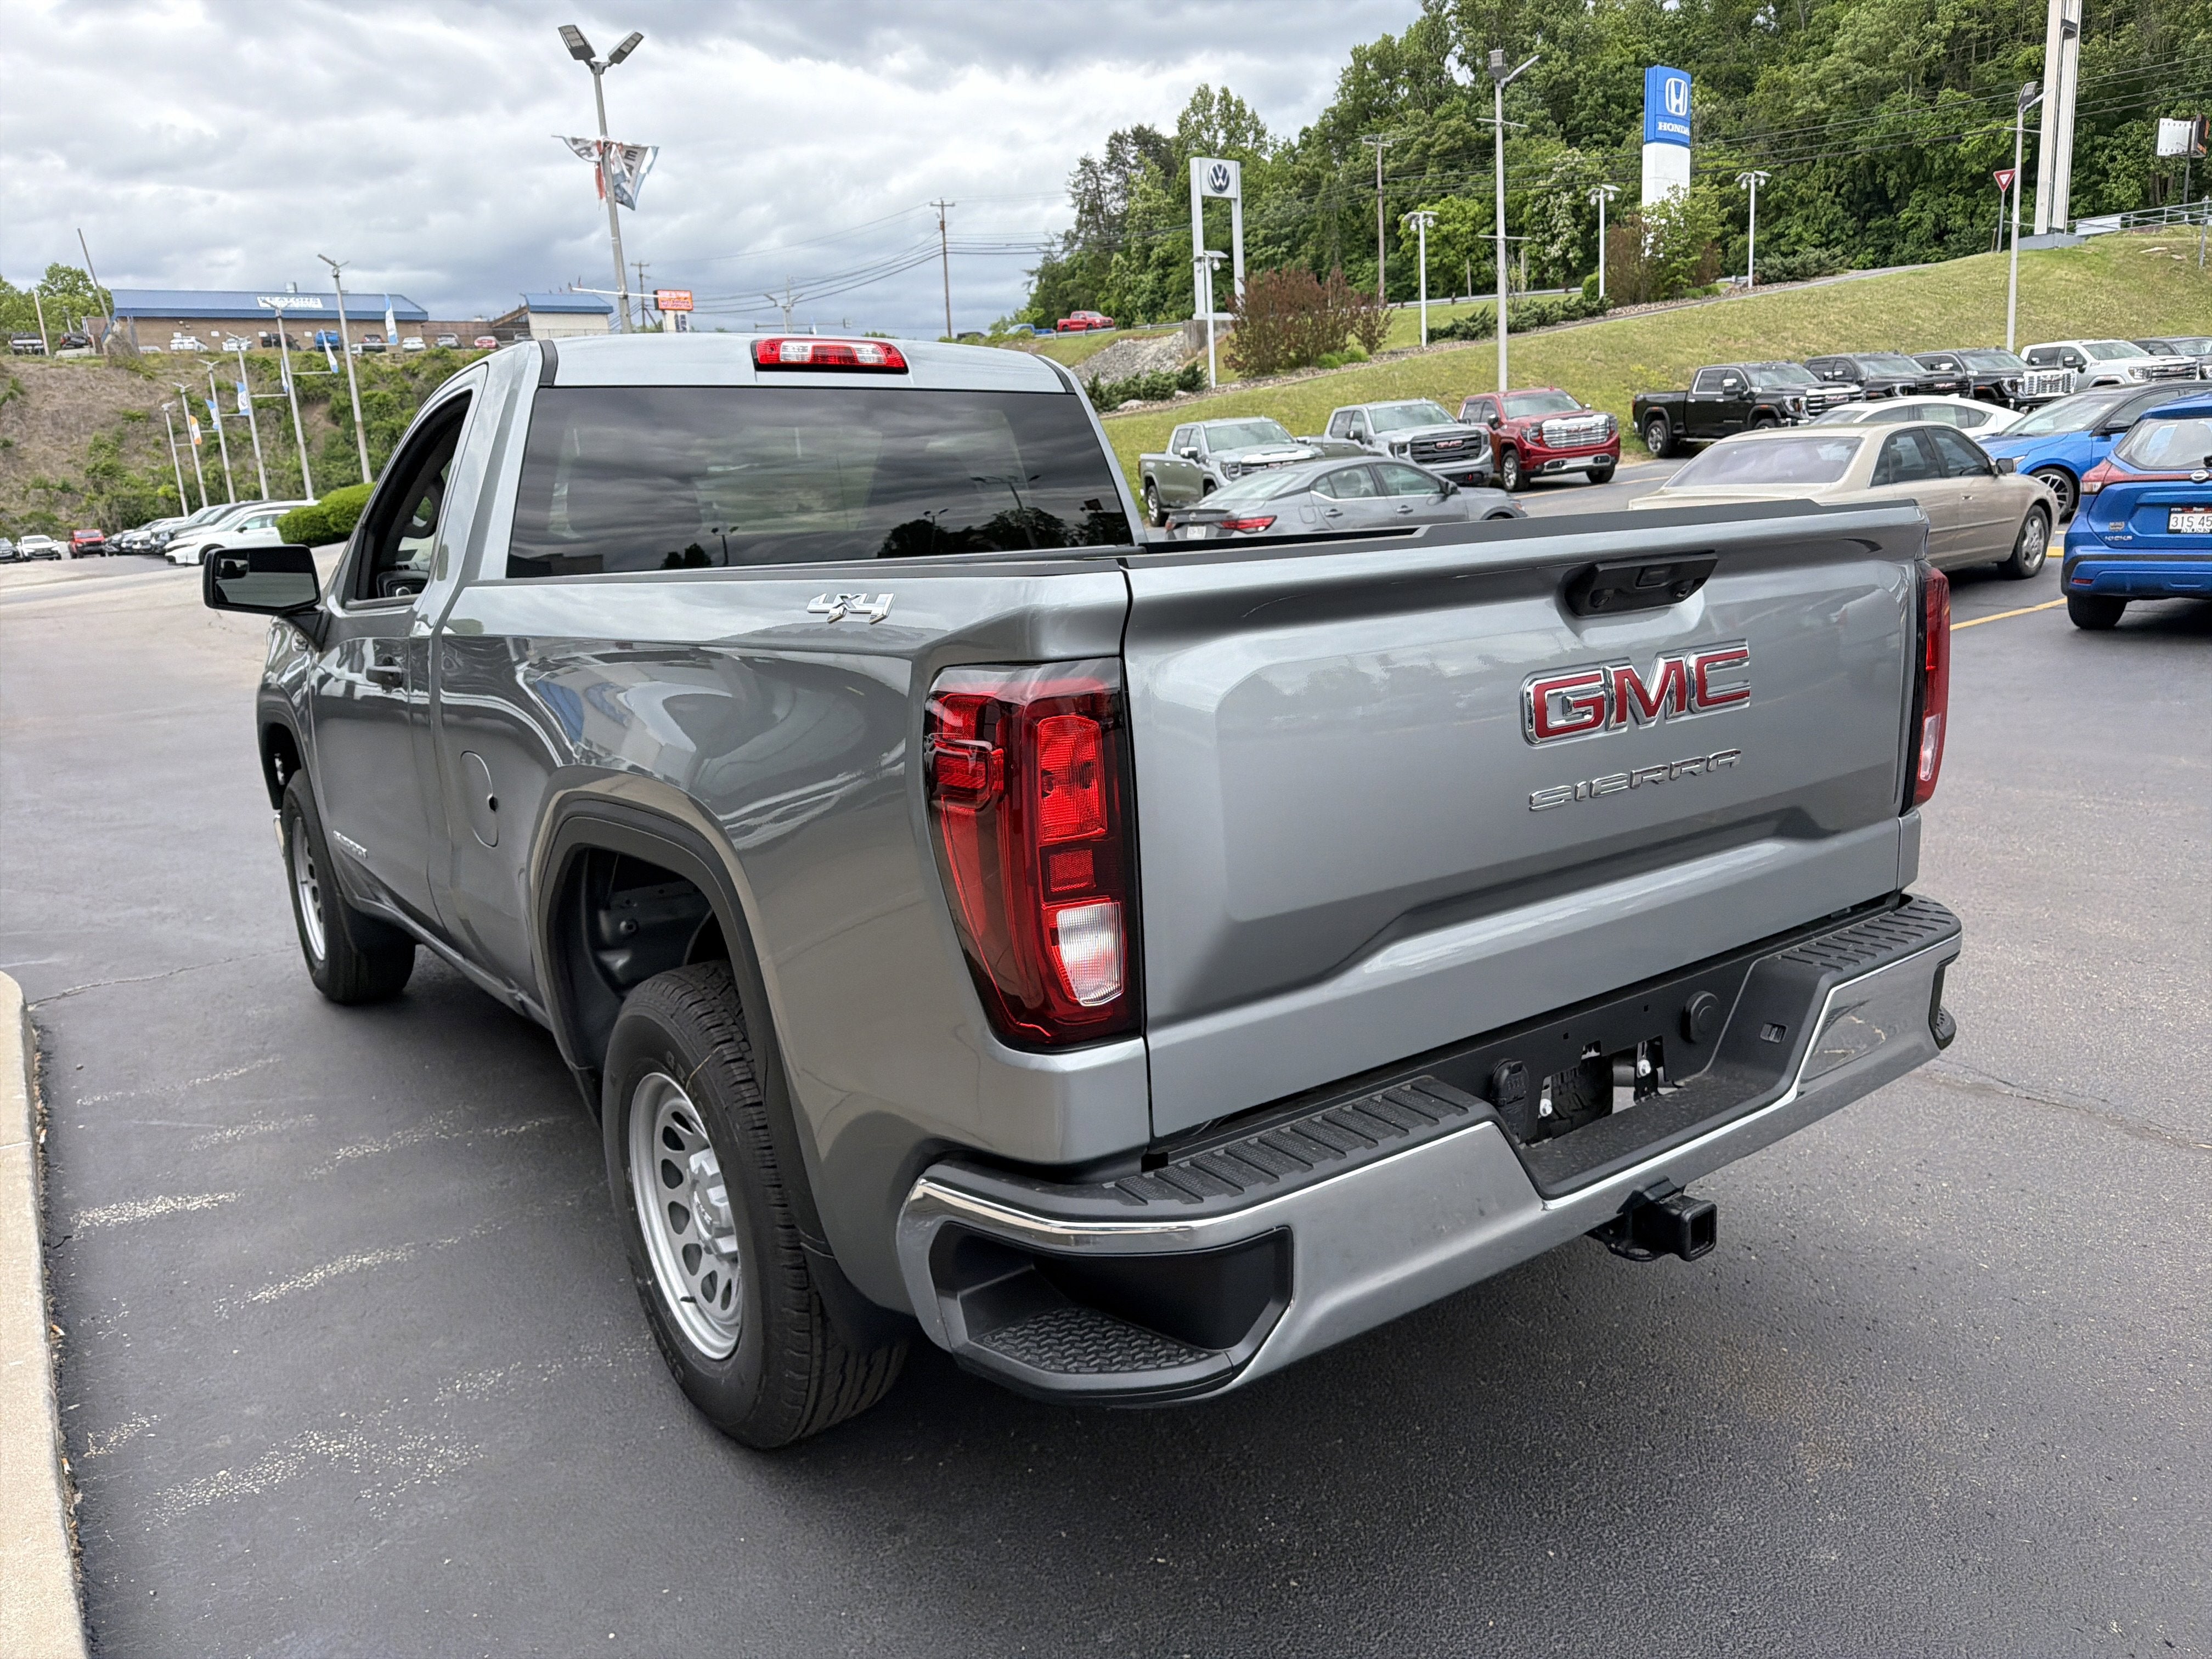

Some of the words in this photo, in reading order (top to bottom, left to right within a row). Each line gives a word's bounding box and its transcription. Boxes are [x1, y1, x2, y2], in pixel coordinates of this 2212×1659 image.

[1657, 121, 1690, 136] HONDA
[1210, 163, 1229, 190] VW
[1521, 640, 1750, 748] GMC
[1529, 748, 1741, 811] SIERRA
